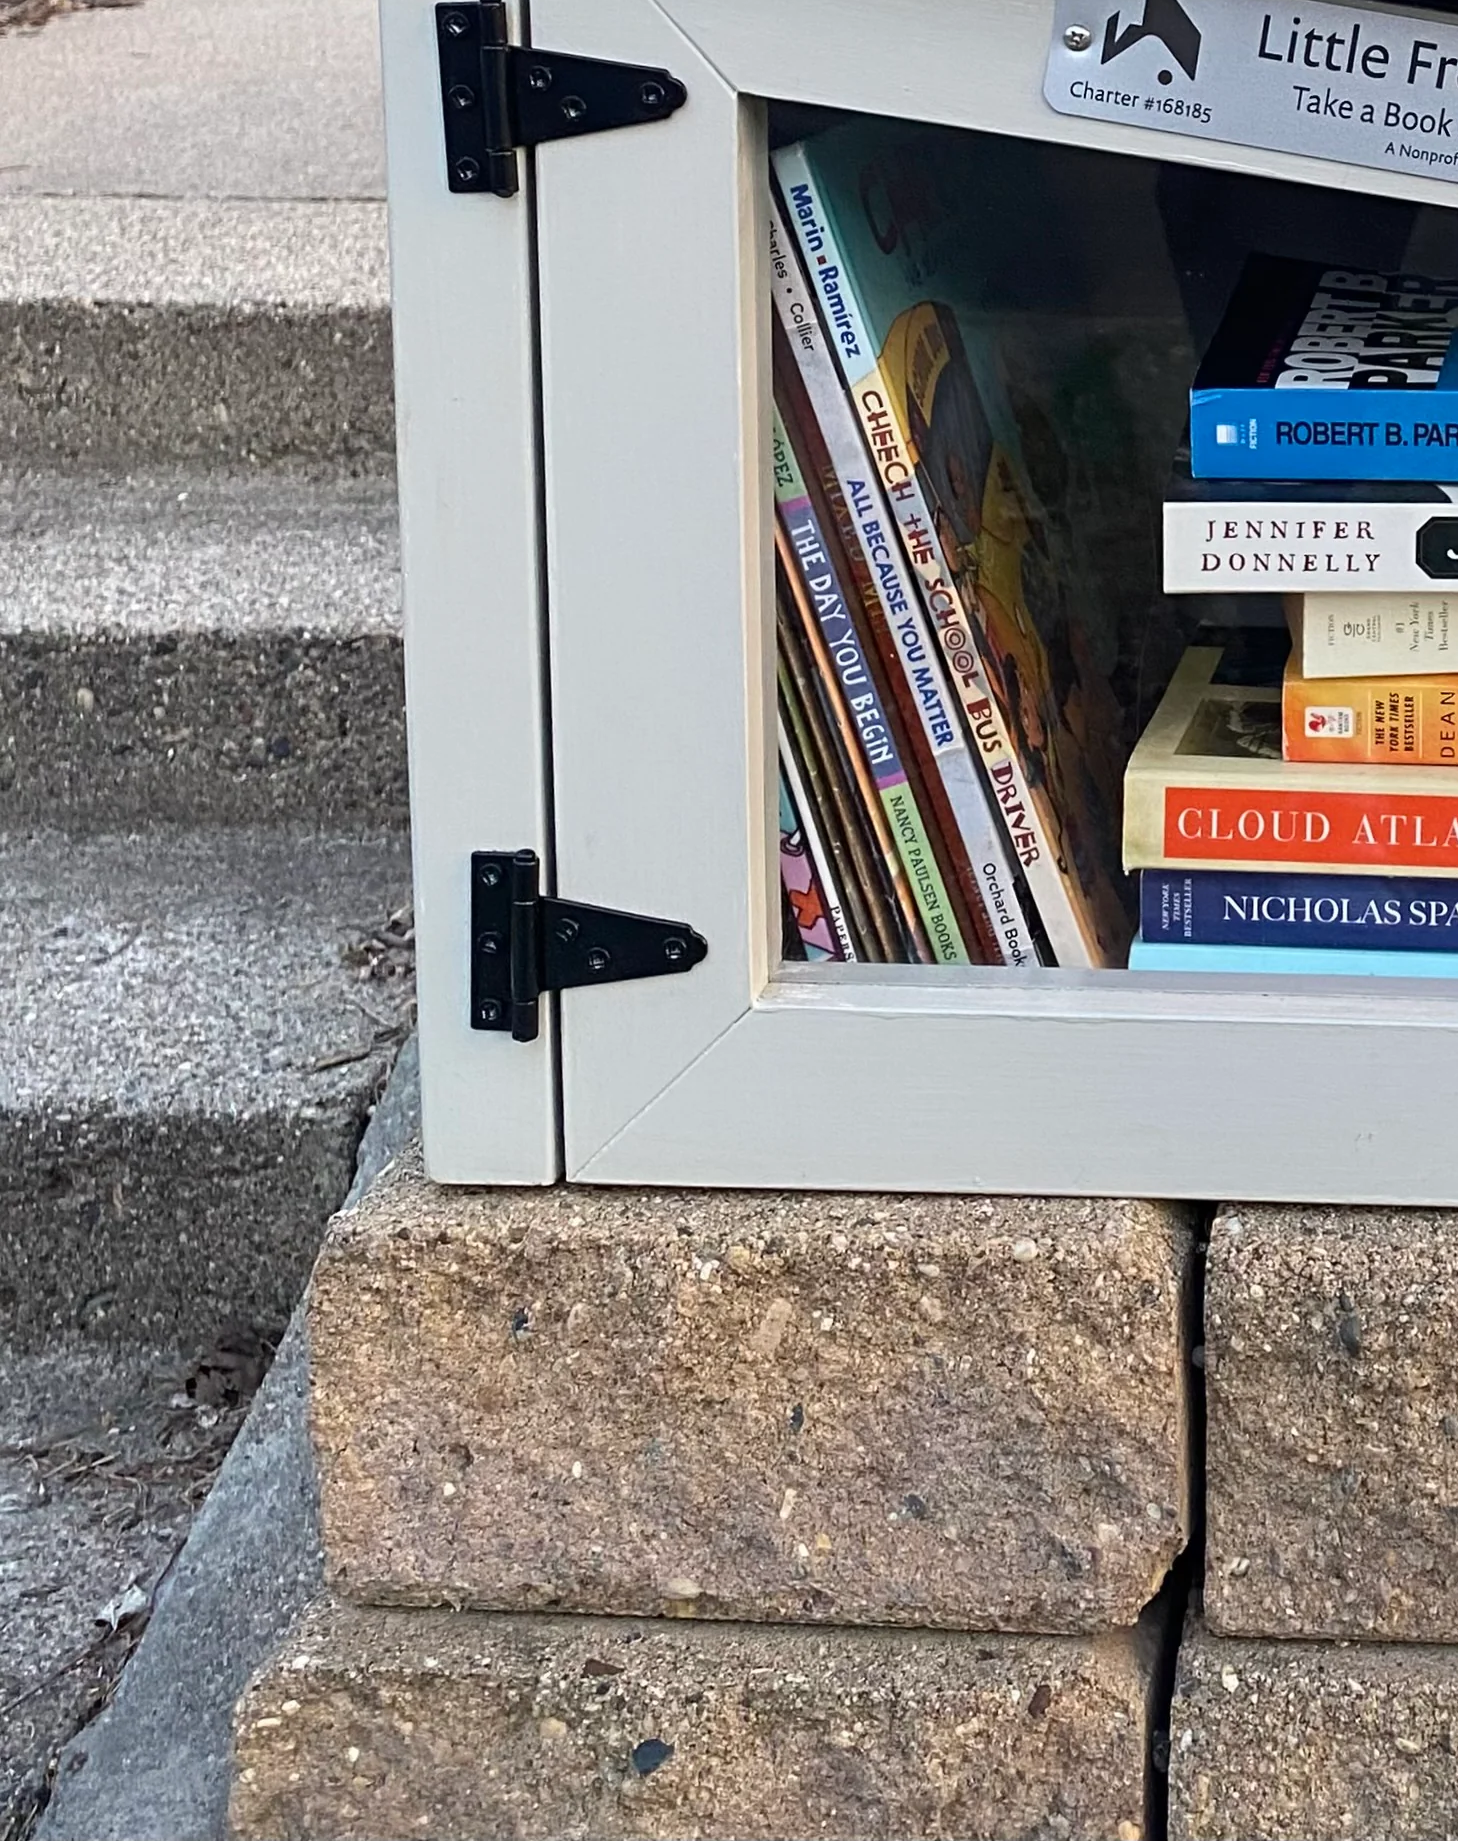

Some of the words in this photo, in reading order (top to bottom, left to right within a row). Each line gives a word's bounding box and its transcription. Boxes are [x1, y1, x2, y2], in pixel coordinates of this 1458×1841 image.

[1258, 14, 1390, 79] Little
[1069, 81, 1139, 112] Charter
[1143, 95, 1214, 125] #168185
[1293, 86, 1355, 123] Take
[1360, 105, 1376, 125] a
[1384, 102, 1452, 138] Book
[1385, 143, 1397, 157] A
[790, 184, 825, 253] Marin
[818, 265, 861, 359] Ramírez
[790, 302, 815, 352] Collier
[1275, 291, 1381, 390] ROBERT
[1275, 420, 1379, 446] ROBERT
[1385, 423, 1408, 447] B.
[1205, 520, 1375, 542] JENNIFER
[1200, 553, 1381, 572] DONNELLY
[791, 519, 826, 570] THE
[809, 574, 846, 622] DAY
[829, 628, 867, 686] YOU
[847, 479, 874, 518] ALL
[862, 519, 908, 616] BECAUSE
[896, 617, 926, 664] YOU
[912, 667, 954, 747] MATTER
[862, 389, 916, 502] CHEECH
[924, 577, 980, 690] SCHOOL
[966, 697, 1003, 753] BUS
[989, 761, 1040, 868] DRIVER
[1375, 699, 1386, 724] NEW
[1389, 692, 1400, 722] TIMES
[1403, 695, 1415, 752] BESTSELLER
[1440, 691, 1455, 758] DEAN
[1375, 727, 1385, 745] THE
[1389, 725, 1400, 753] YORK
[1177, 807, 1331, 844] CLOUD
[890, 795, 918, 844] NANCY
[908, 847, 940, 912] PAULSEN
[931, 914, 957, 961] BOOKS
[983, 862, 1015, 926] Orchard
[1161, 883, 1170, 908] YORK
[1161, 907, 1170, 931] NEW
[1173, 891, 1181, 922] TIMES
[1183, 878, 1192, 937] BESTSELLER
[1222, 895, 1402, 926] NICHOLAS
